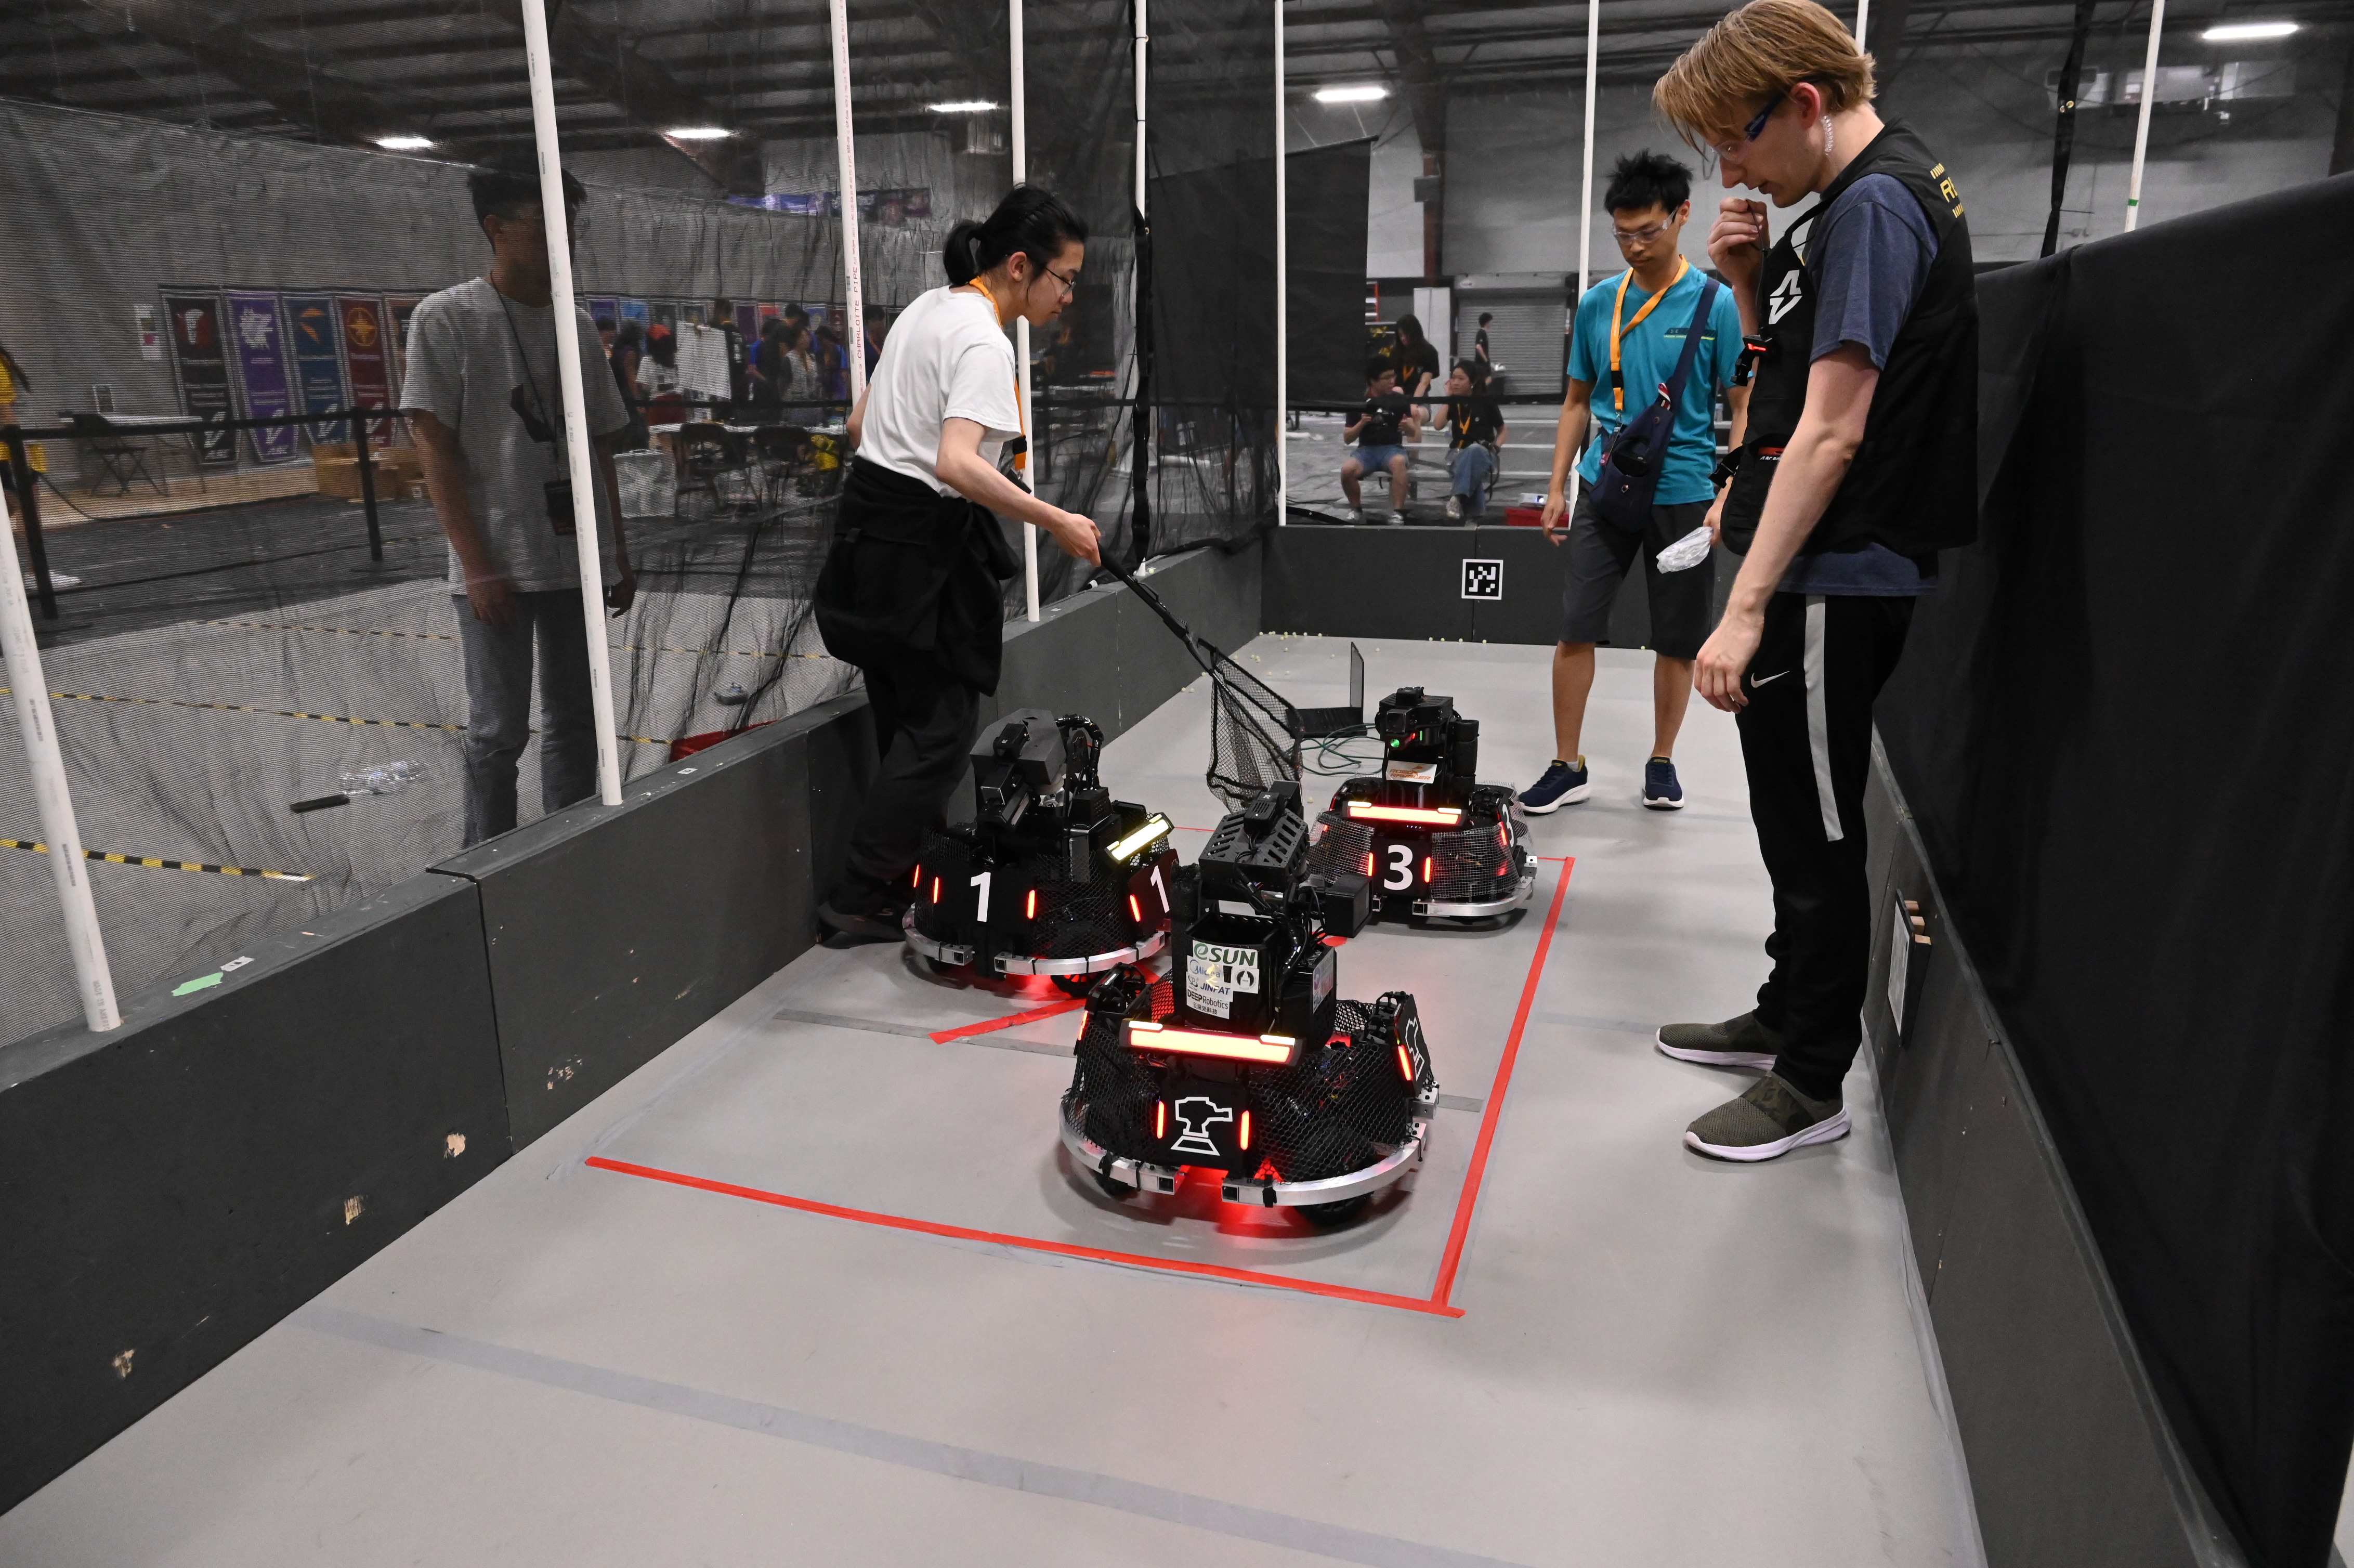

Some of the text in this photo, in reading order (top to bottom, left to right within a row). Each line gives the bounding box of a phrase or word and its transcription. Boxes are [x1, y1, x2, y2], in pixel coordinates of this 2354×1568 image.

[1502, 803, 1514, 847] 3
[1150, 865, 1170, 913] 1
[1384, 844, 1413, 891] 3
[971, 872, 991, 922] 1
[1200, 983, 1231, 995] JINPAT
[100, 1009, 110, 1030] AMERIC
